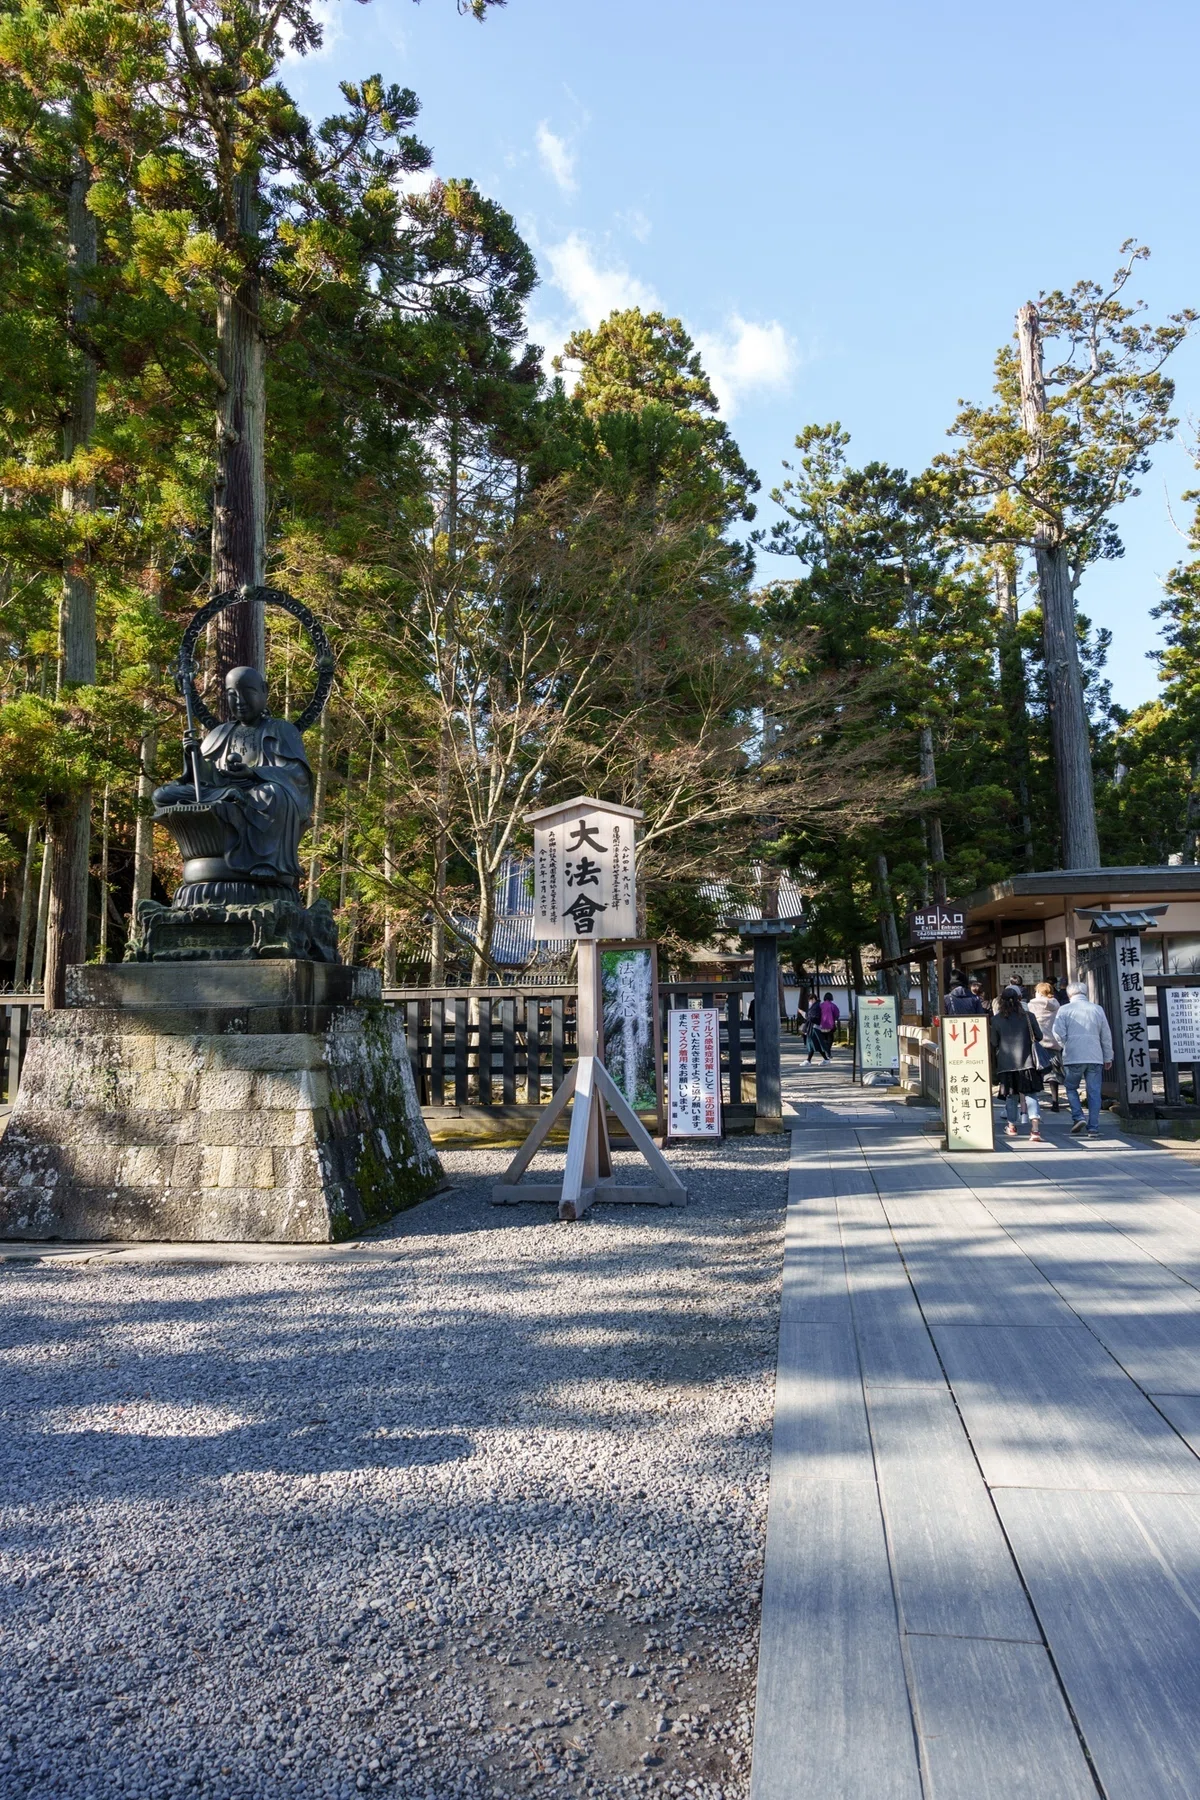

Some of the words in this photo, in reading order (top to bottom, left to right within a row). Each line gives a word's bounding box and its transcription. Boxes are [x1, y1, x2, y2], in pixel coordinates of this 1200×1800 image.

[562, 820, 608, 934] 大法會
[915, 915, 936, 925] 出口
[941, 914, 963, 923] 入口
[618, 962, 636, 1018] 法身伝心
[881, 1012, 893, 1038] 受付
[1119, 946, 1149, 1093] 拝観者受付所
[950, 1075, 962, 1139] お願いします。
[961, 1075, 971, 1133] 右側通行で
[973, 1071, 986, 1109] 入口
